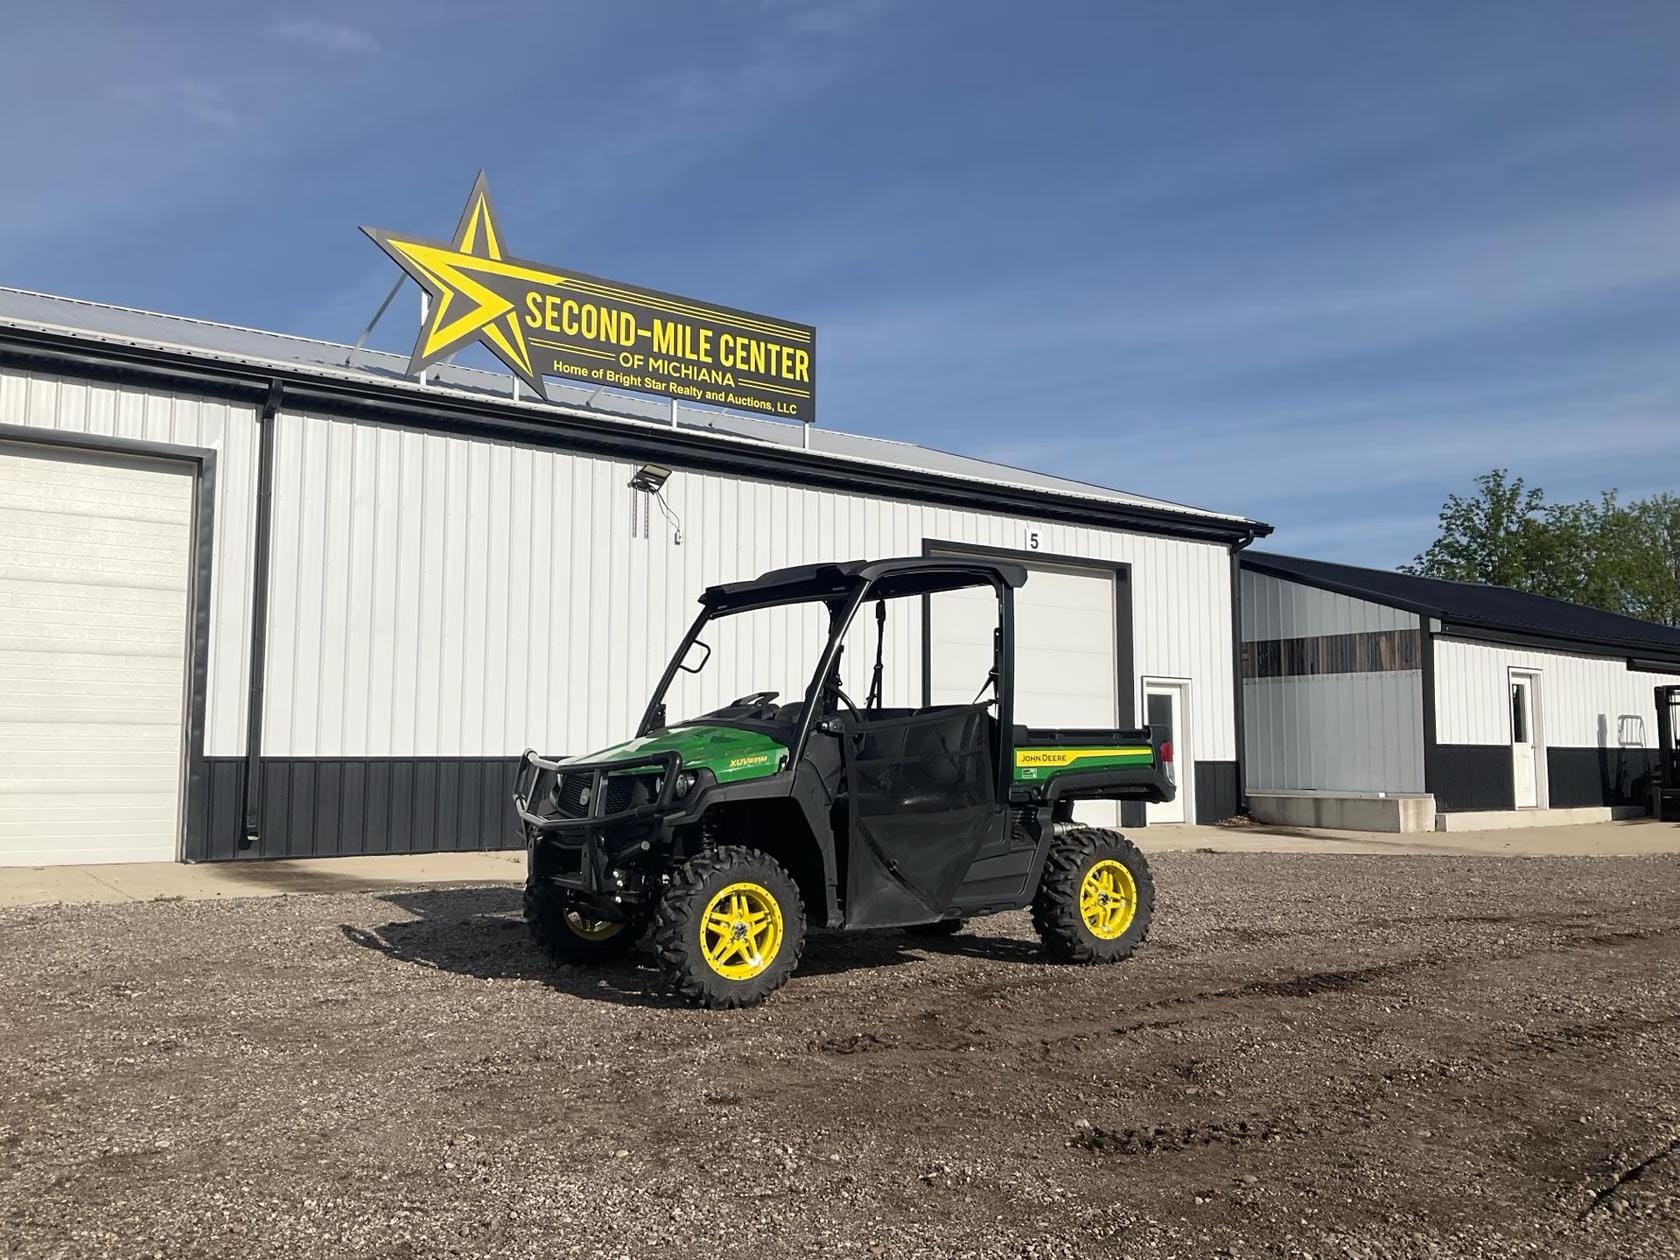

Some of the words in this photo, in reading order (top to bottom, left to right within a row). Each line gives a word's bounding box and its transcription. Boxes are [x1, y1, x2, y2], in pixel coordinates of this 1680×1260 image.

[525, 291, 713, 364] SECOND-MILE
[719, 333, 809, 383] CENTER
[553, 360, 589, 377] Home
[591, 368, 605, 380] of
[606, 370, 642, 389] Bright
[644, 377, 666, 391] Star
[669, 383, 703, 401] Realty
[705, 389, 725, 402] and
[727, 392, 775, 413] Auctions,
[777, 401, 798, 415] LLC
[619, 352, 644, 369] OF
[648, 357, 735, 388] MICHIANA
[1030, 533, 1039, 549] 5
[1021, 754, 1041, 762] JOHN
[1042, 754, 1066, 762] DEERE
